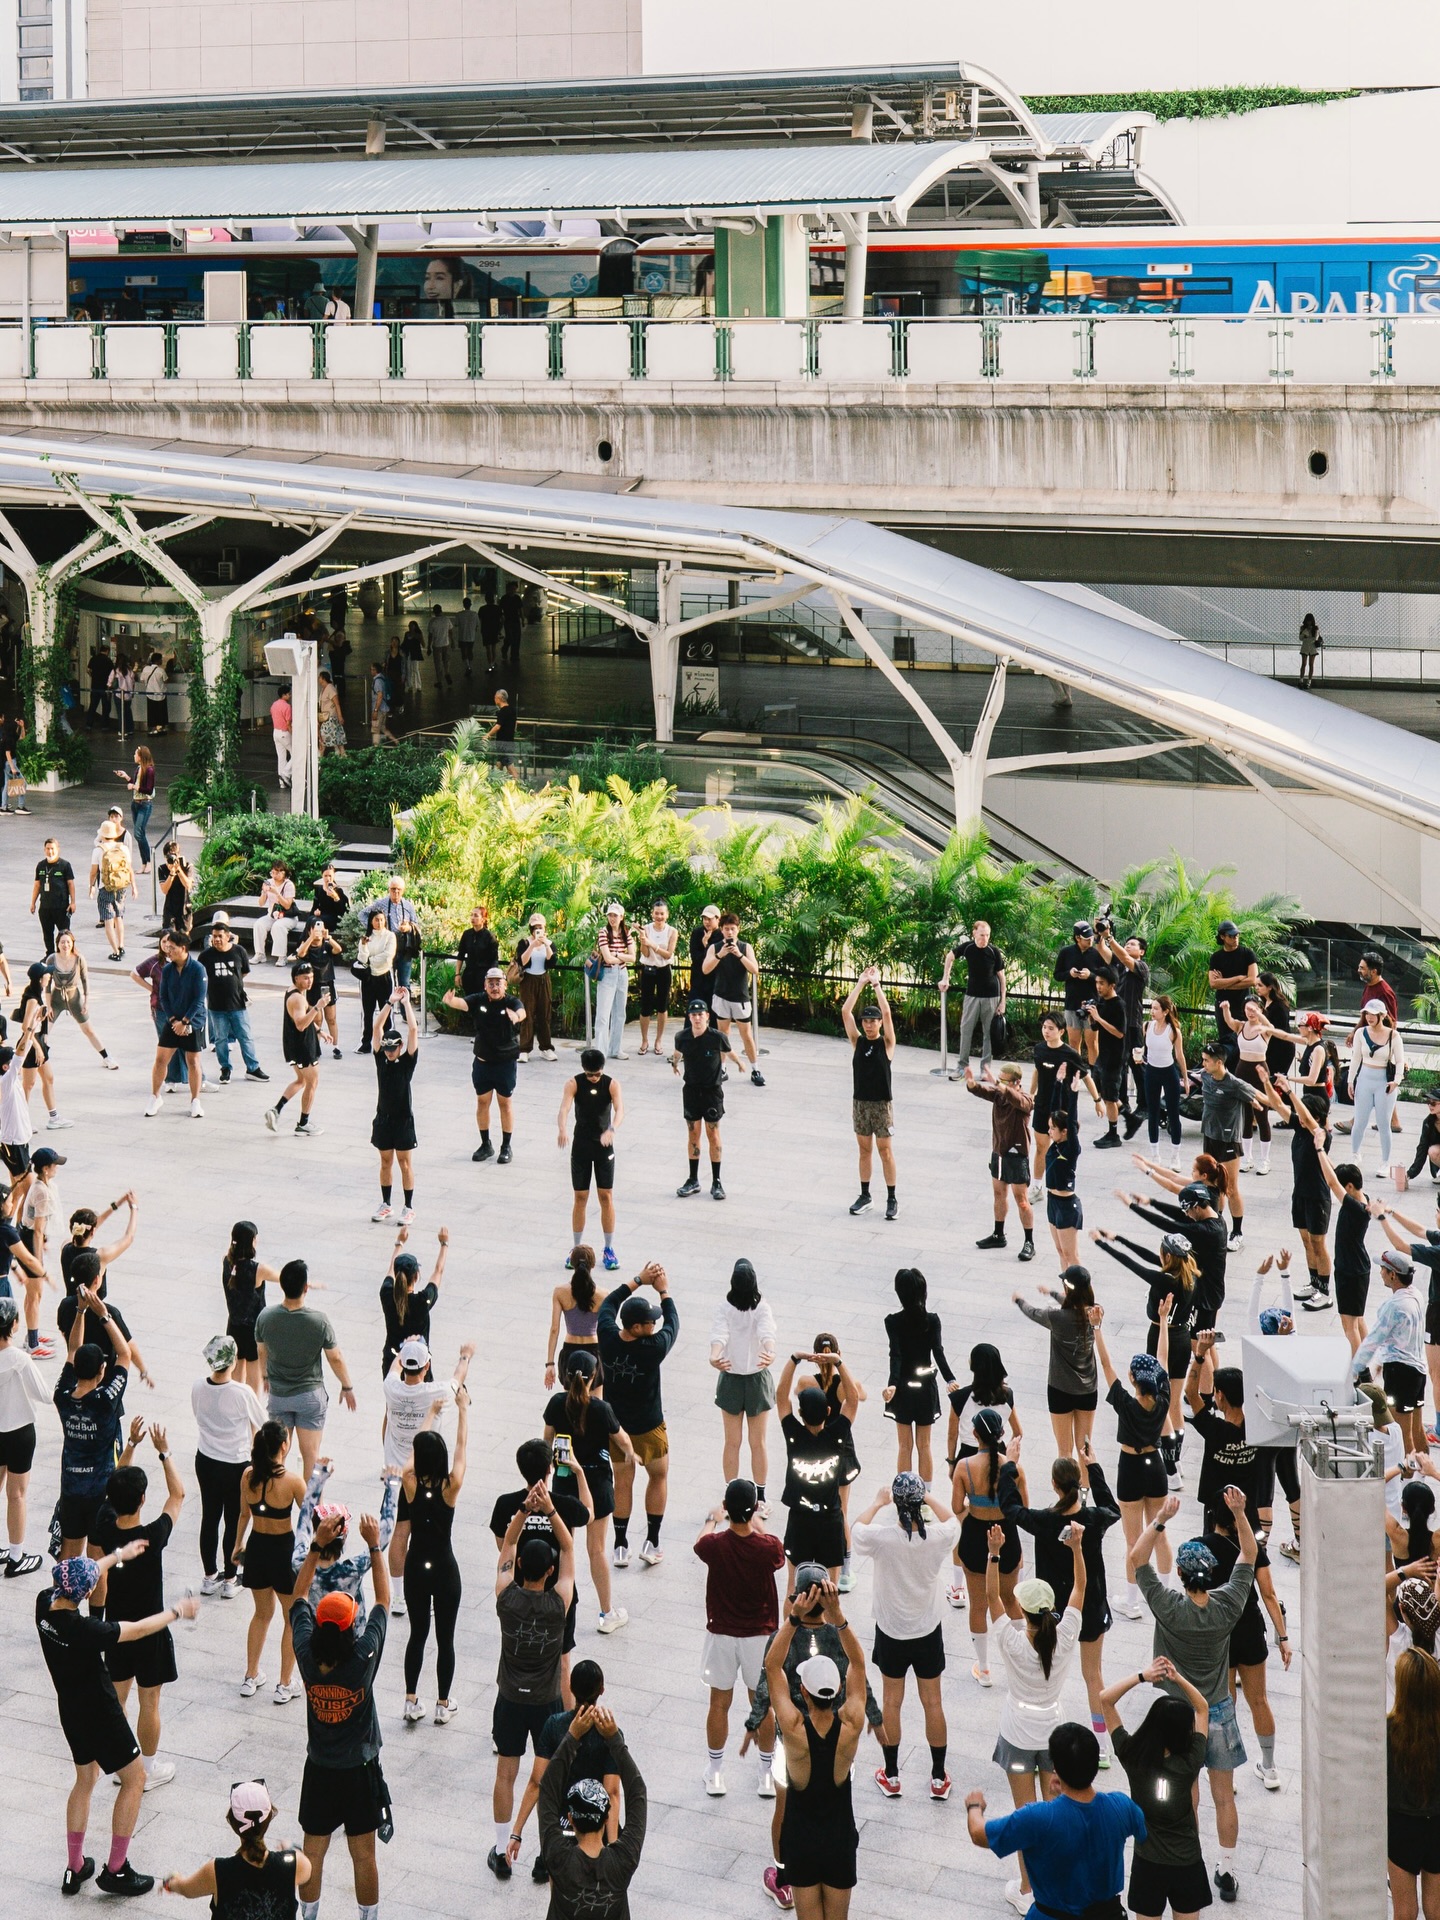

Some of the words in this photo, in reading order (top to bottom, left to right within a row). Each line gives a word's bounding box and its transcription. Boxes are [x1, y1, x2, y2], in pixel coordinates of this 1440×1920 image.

[478, 260, 500, 268] 2994
[65, 1420, 80, 1430] Red
[81, 1423, 97, 1431] Bull
[1213, 1453, 1234, 1464] RUN
